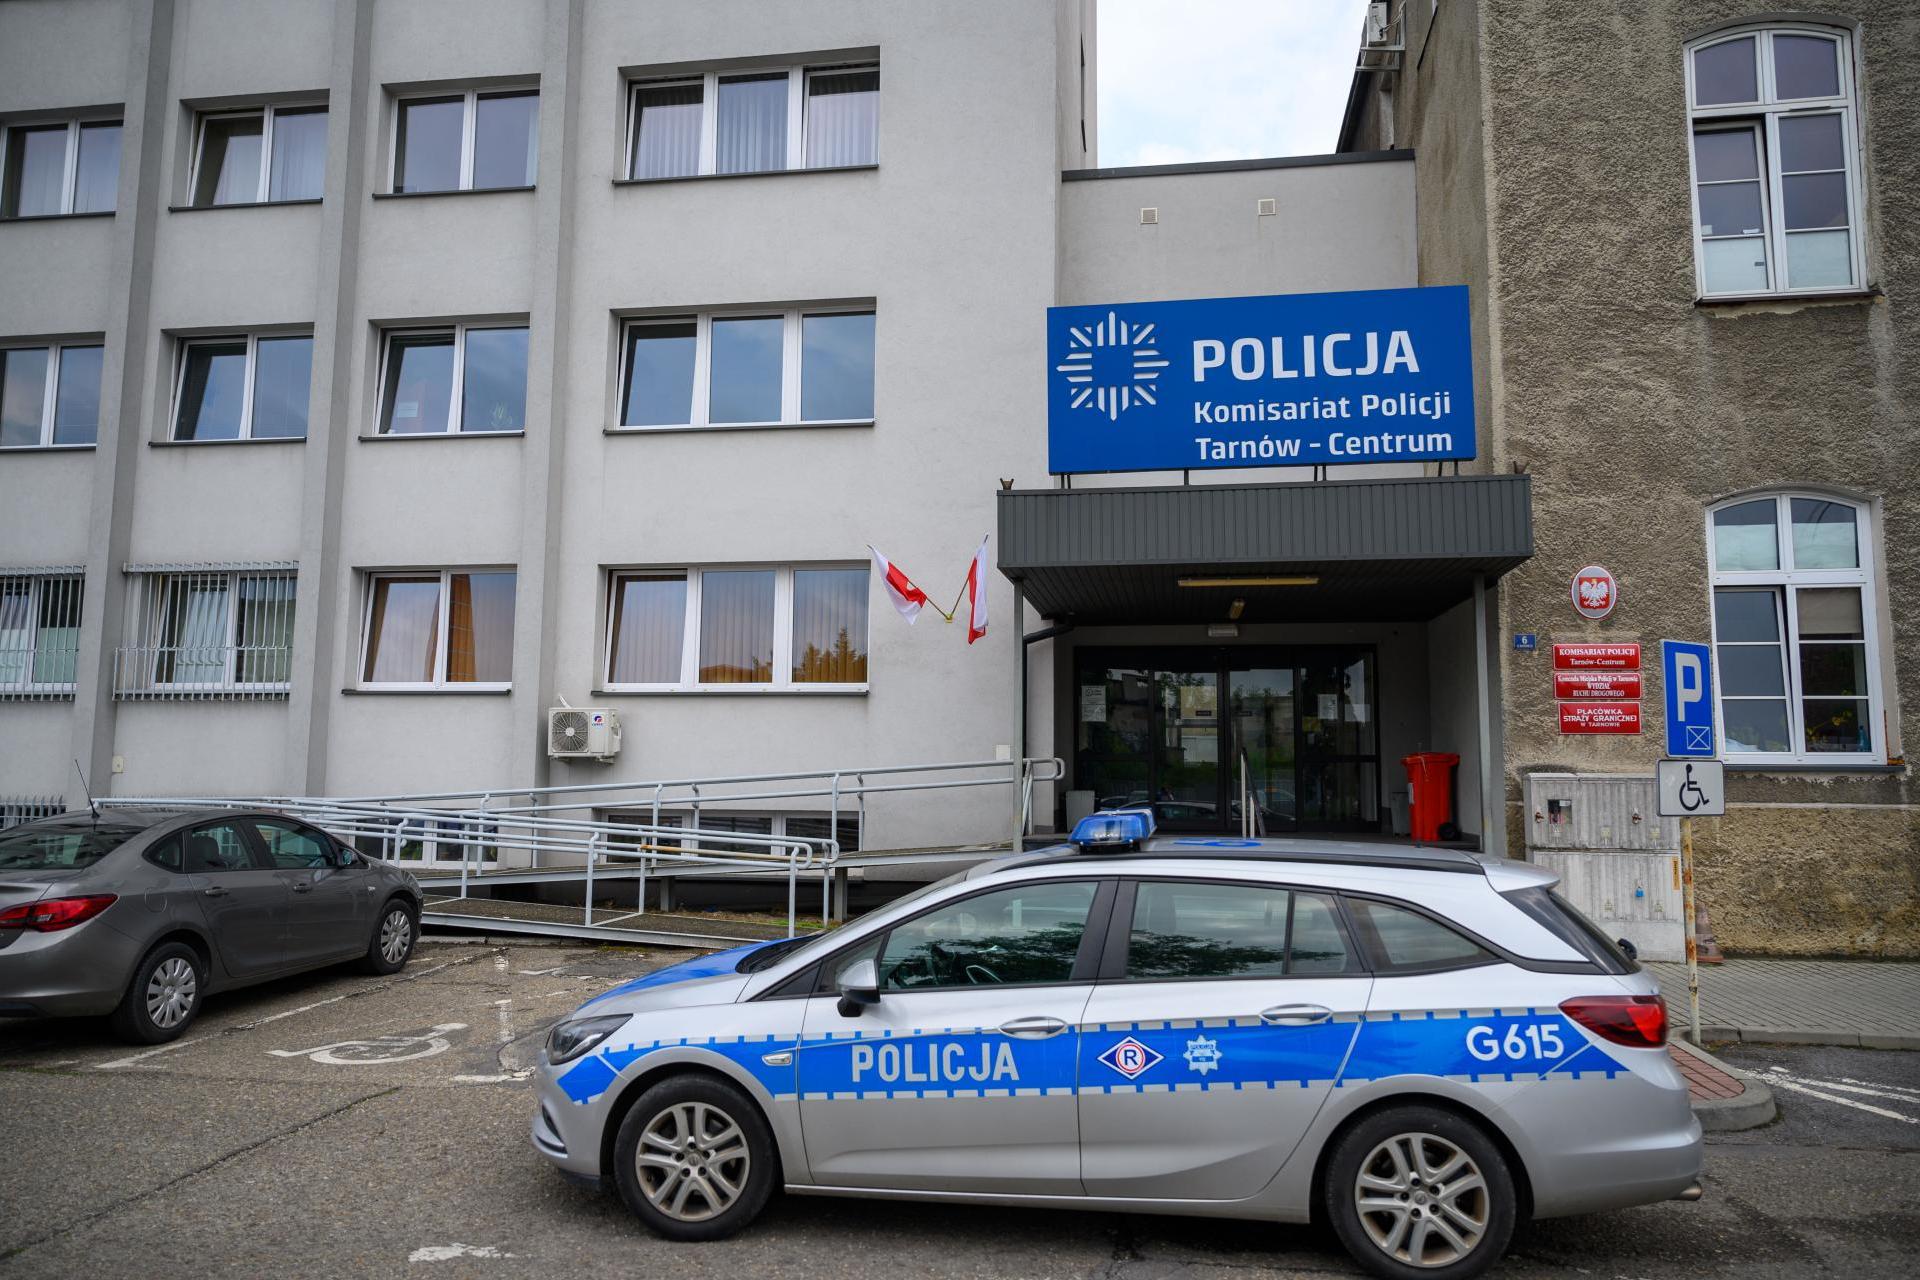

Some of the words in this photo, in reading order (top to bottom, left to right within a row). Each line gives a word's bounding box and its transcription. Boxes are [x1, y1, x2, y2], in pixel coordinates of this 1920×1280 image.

[1193, 330, 1420, 382] POLICJA
[1194, 397, 1351, 424] Komisariat
[1362, 391, 1452, 420] Policji
[1195, 434, 1301, 460] Tarnów
[1329, 431, 1453, 457] Centrum
[1521, 635, 1528, 645] 6
[1559, 648, 1606, 656] KOMISARIAT
[1607, 648, 1635, 656] POLICJI
[1675, 652, 1702, 722] P
[1124, 1049, 1138, 1066] R
[1466, 1023, 1565, 1062] G615
[851, 1042, 1020, 1083] POLICJA
